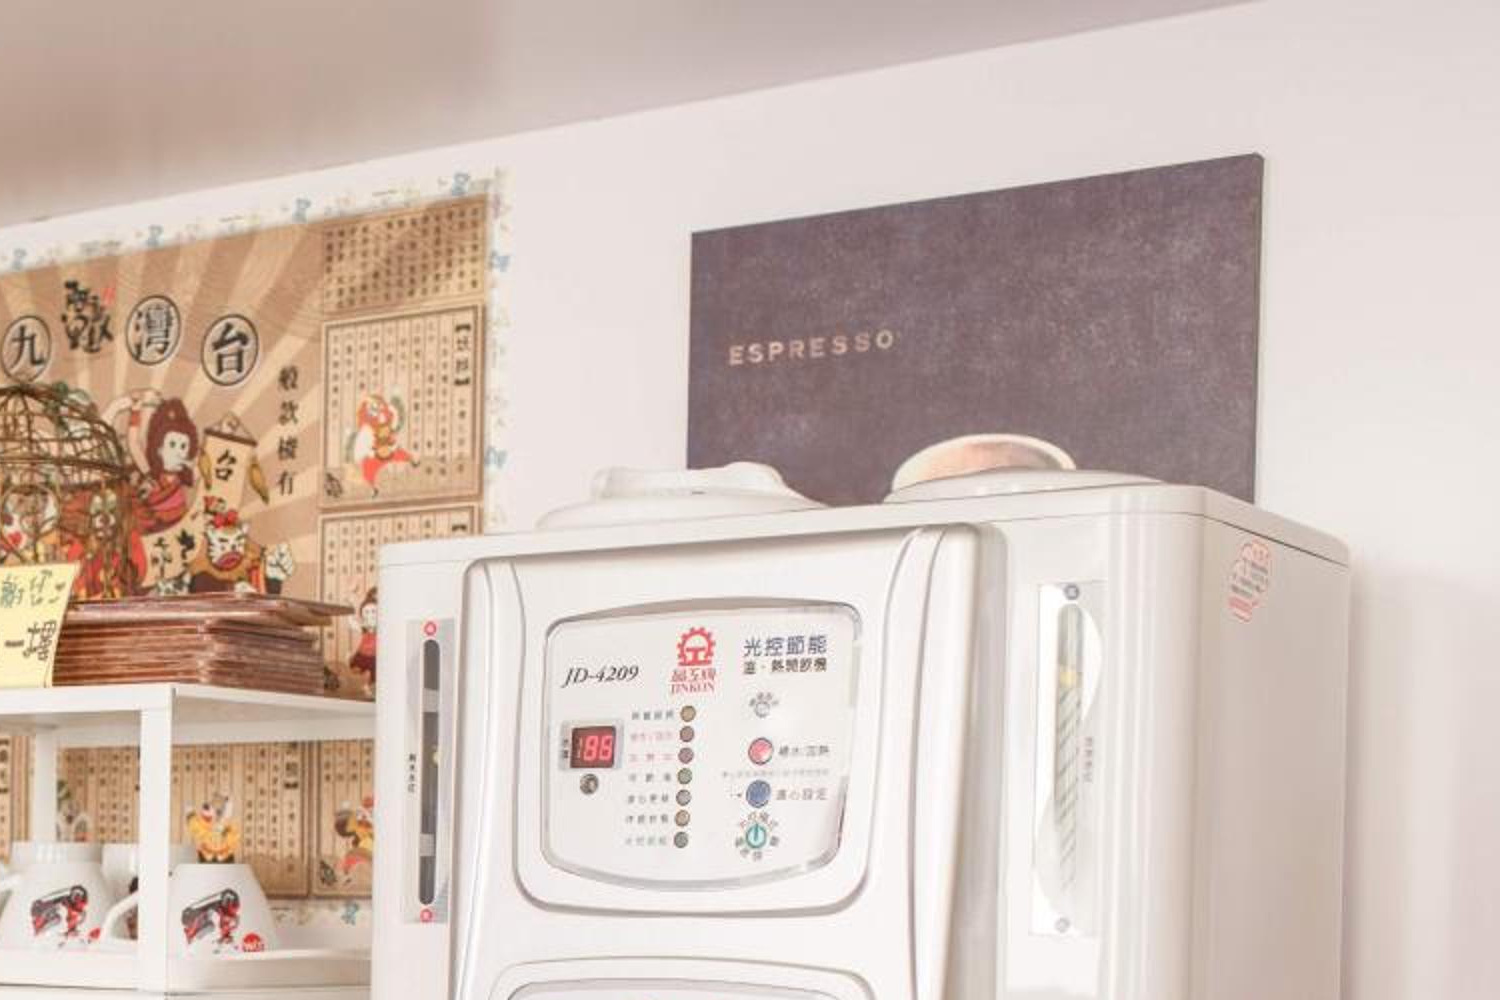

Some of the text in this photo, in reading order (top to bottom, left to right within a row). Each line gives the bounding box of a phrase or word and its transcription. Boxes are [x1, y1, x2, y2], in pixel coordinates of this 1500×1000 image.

[729, 330, 894, 366] ESPRESSO
[743, 635, 828, 657] 光控節能
[562, 665, 639, 688] JD-4209
